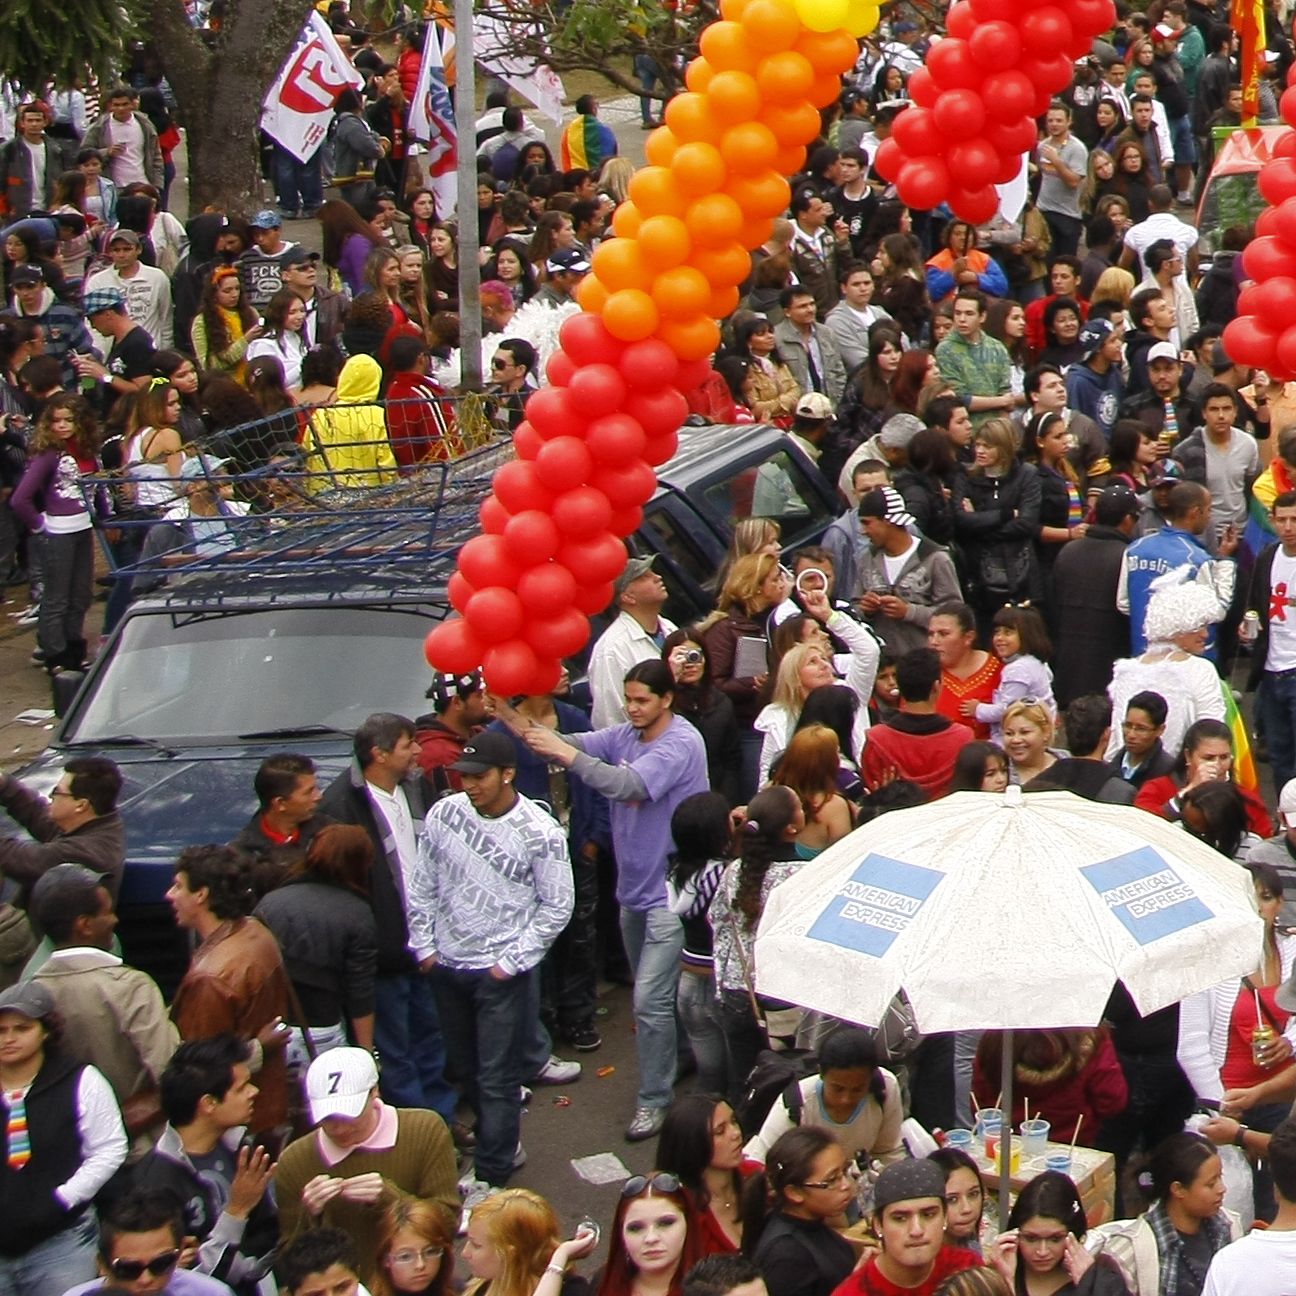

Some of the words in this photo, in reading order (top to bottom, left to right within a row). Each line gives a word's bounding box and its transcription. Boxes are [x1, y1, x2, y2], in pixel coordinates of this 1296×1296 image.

[251, 265, 282, 284] ECK
[840, 881, 919, 914] AMERICAN
[1103, 871, 1175, 905] AMERICAN
[1130, 885, 1195, 916] EXPRESS
[843, 905, 911, 931] EXPRESS
[328, 1071, 343, 1095] 7
